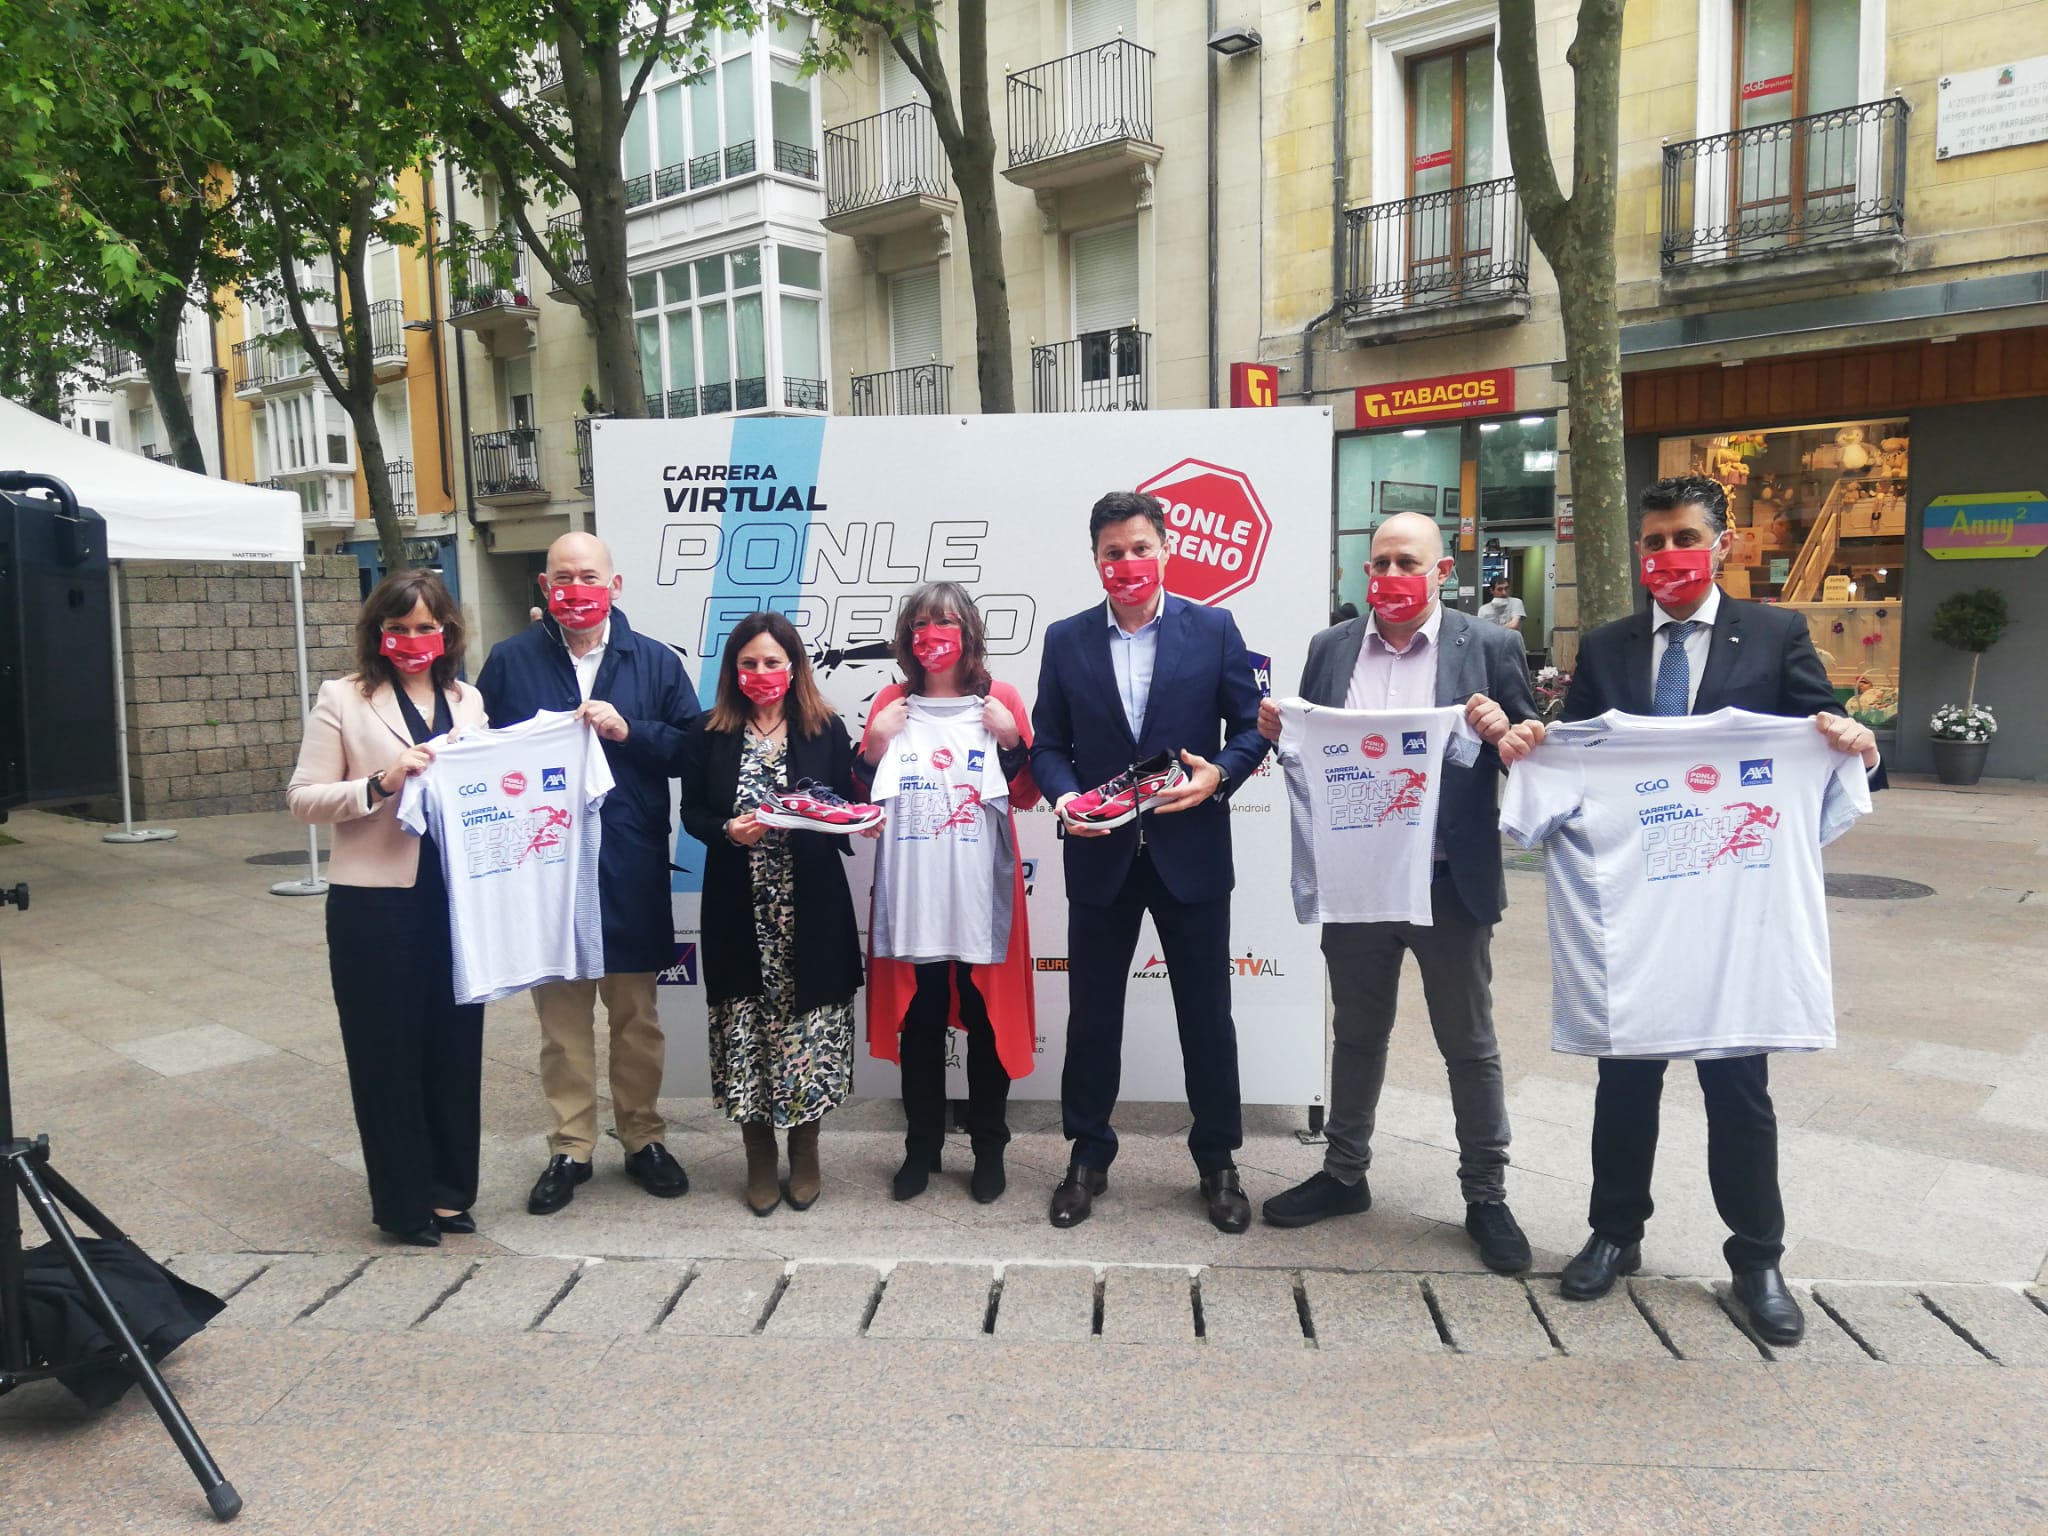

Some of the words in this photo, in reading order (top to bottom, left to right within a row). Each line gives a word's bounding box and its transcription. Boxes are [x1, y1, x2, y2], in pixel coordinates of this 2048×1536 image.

[1391, 379, 1496, 408] TABACOS
[662, 464, 778, 481] CARRERA
[663, 486, 828, 512] VIRTUAL
[1154, 496, 1253, 546] PONLE
[656, 520, 989, 586] PONLE
[1165, 528, 1244, 571] RENO
[697, 593, 1037, 658] FREO
[1252, 668, 1271, 691] XA
[1403, 738, 1427, 750] AXA
[1325, 766, 1359, 775] CARRERA
[1326, 771, 1376, 783] VIRTUAL
[1689, 771, 1717, 781] PONLE
[1742, 766, 1772, 781] AXA
[543, 774, 567, 787] AXA
[899, 782, 938, 791] IRTUAL
[461, 806, 498, 818] CARRERA
[1231, 804, 1271, 813] Android
[1639, 803, 1683, 816] CARRERA
[463, 811, 515, 827] VIRTUAL
[1640, 808, 1703, 826] VIRTUAL
[656, 964, 690, 982] AXA
